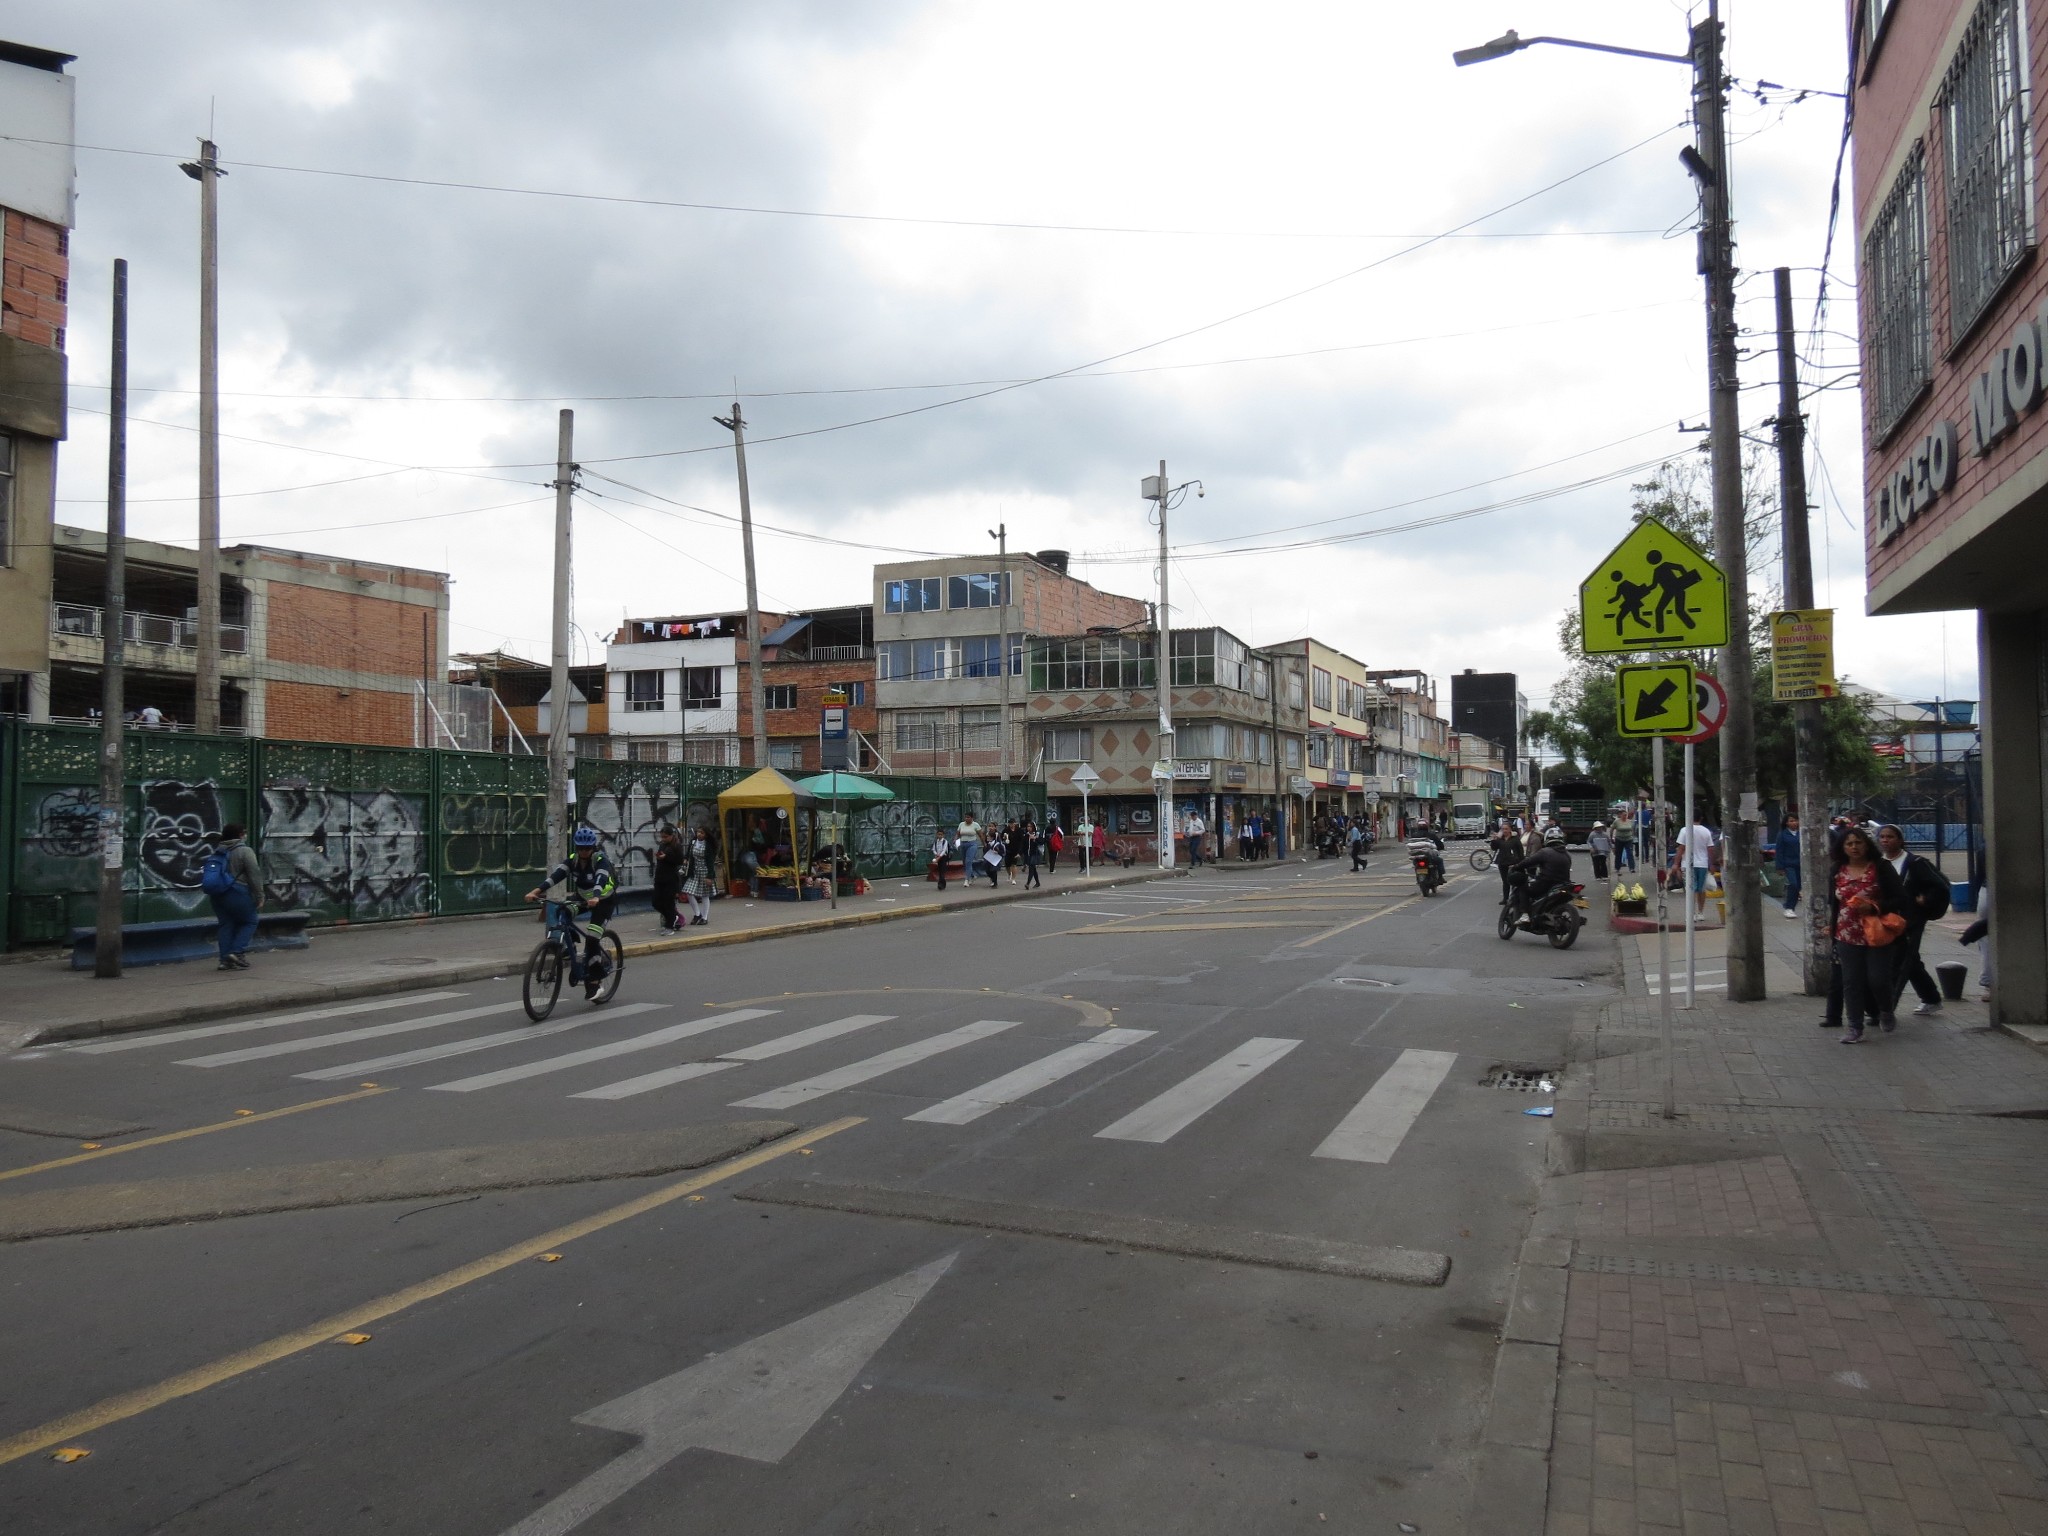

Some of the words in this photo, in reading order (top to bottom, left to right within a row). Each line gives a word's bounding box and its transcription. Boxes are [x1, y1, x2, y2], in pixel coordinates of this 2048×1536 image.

[1876, 421, 1957, 548] LICEO
[1792, 624, 1813, 632] GRAN
[1778, 634, 1828, 644] PROMOCION
[1131, 810, 1152, 823] CB
